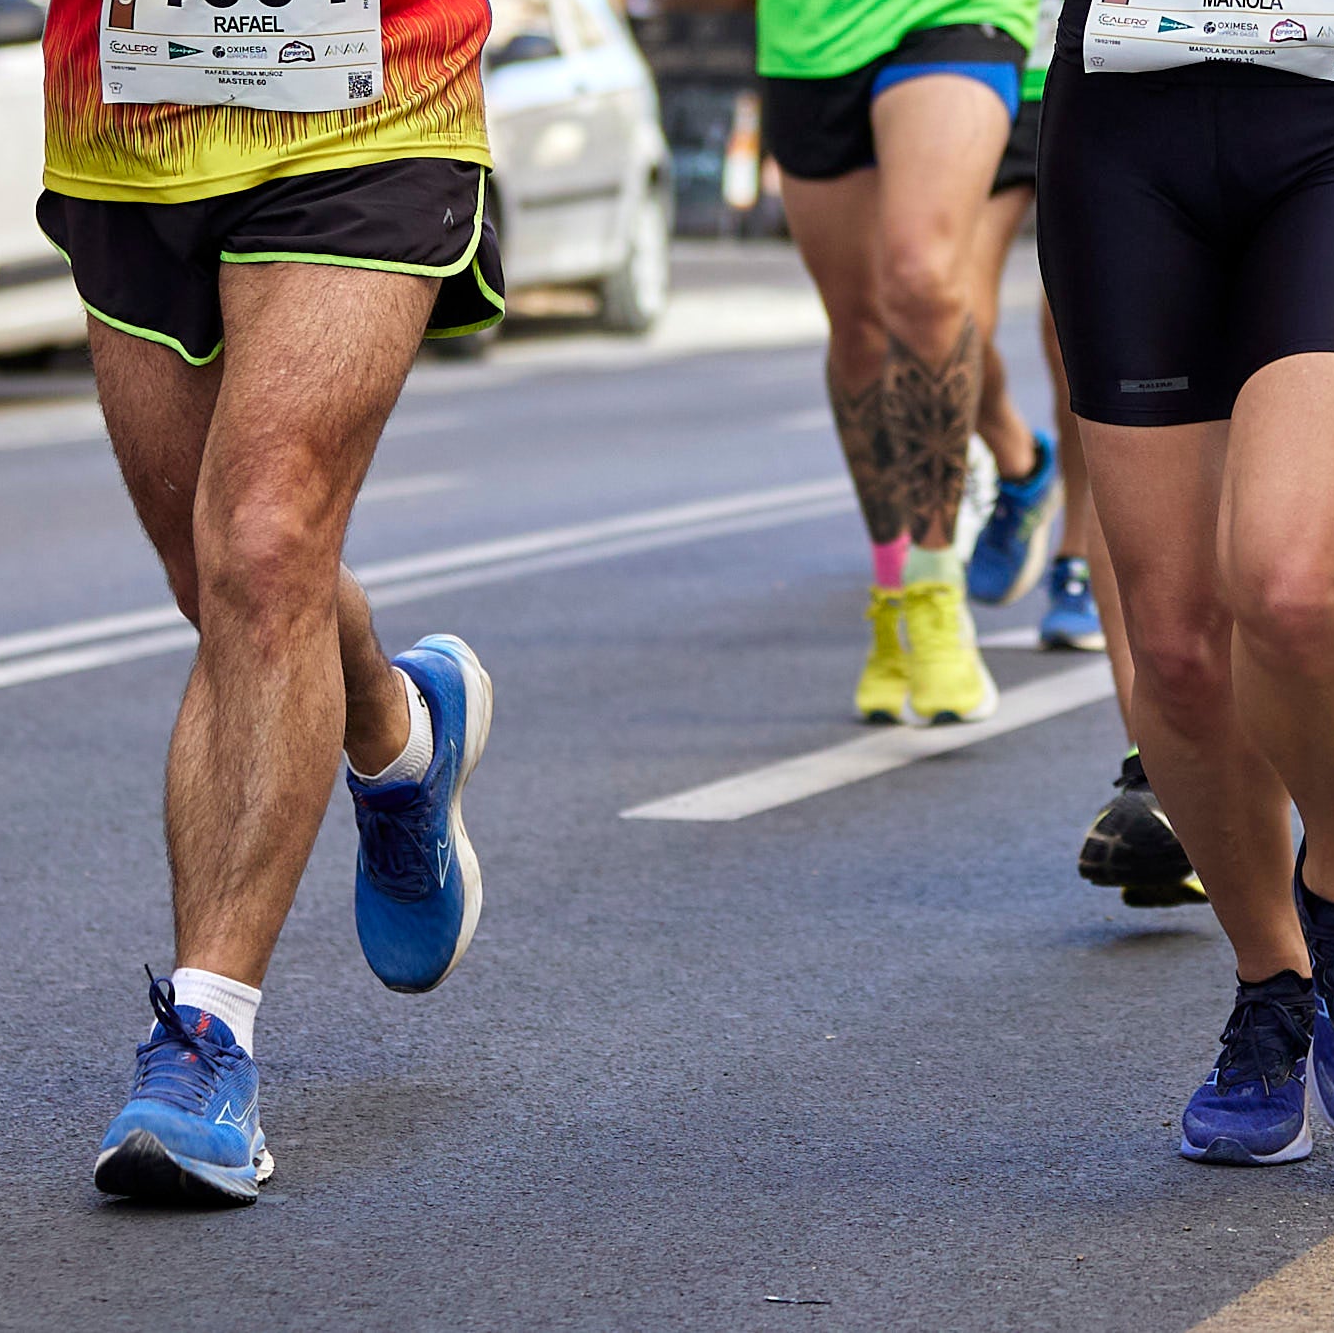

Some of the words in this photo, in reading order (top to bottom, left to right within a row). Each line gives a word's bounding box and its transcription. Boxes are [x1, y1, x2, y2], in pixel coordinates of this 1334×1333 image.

[214, 16, 285, 33] RAFAEL
[1099, 14, 1149, 27] CALERO
[1218, 22, 1259, 31] OXIMESA
[110, 40, 158, 54] CALERO
[226, 46, 268, 54] OXIMESA
[325, 42, 369, 57] ANAYA
[1188, 46, 1220, 54] MARIOLA
[218, 78, 255, 86] MASTER
